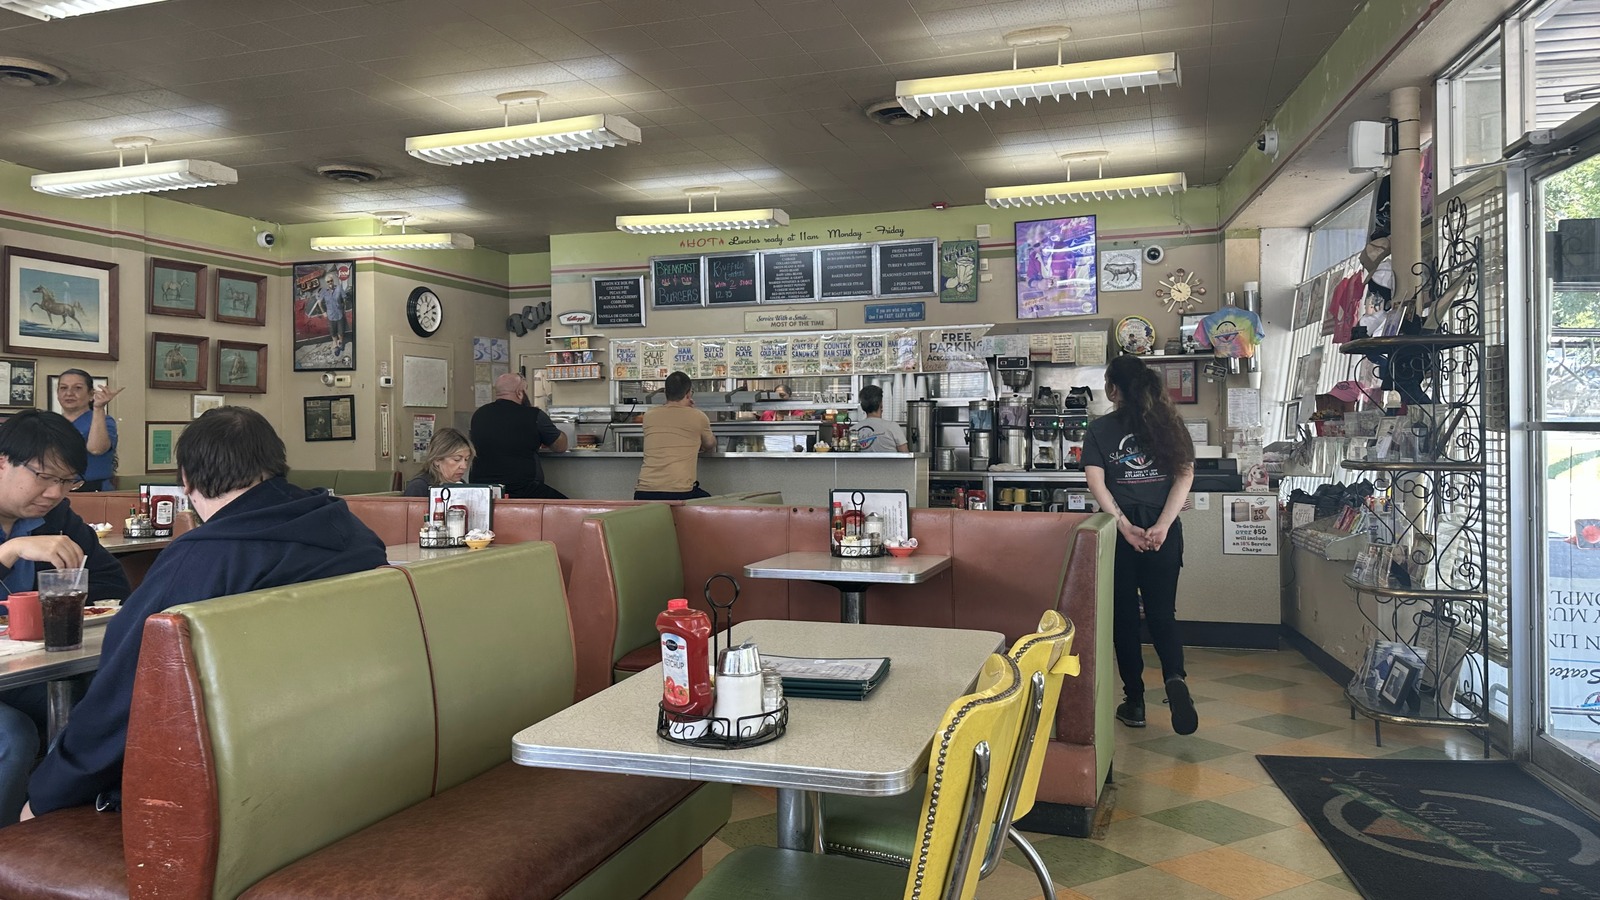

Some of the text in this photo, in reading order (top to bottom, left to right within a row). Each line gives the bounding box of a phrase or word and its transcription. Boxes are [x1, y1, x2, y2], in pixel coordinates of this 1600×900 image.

[686, 238, 718, 247] HOT
[728, 236, 760, 246] Lunches
[764, 234, 783, 245] ready
[787, 233, 796, 241] at
[800, 232, 819, 240] 11am
[827, 229, 862, 240] Monday
[875, 226, 904, 237] Friday
[656, 262, 697, 276] BREAKFAST
[658, 288, 698, 303] BURGERS
[942, 332, 971, 342] FREE
[1549, 607, 1587, 623] MU
